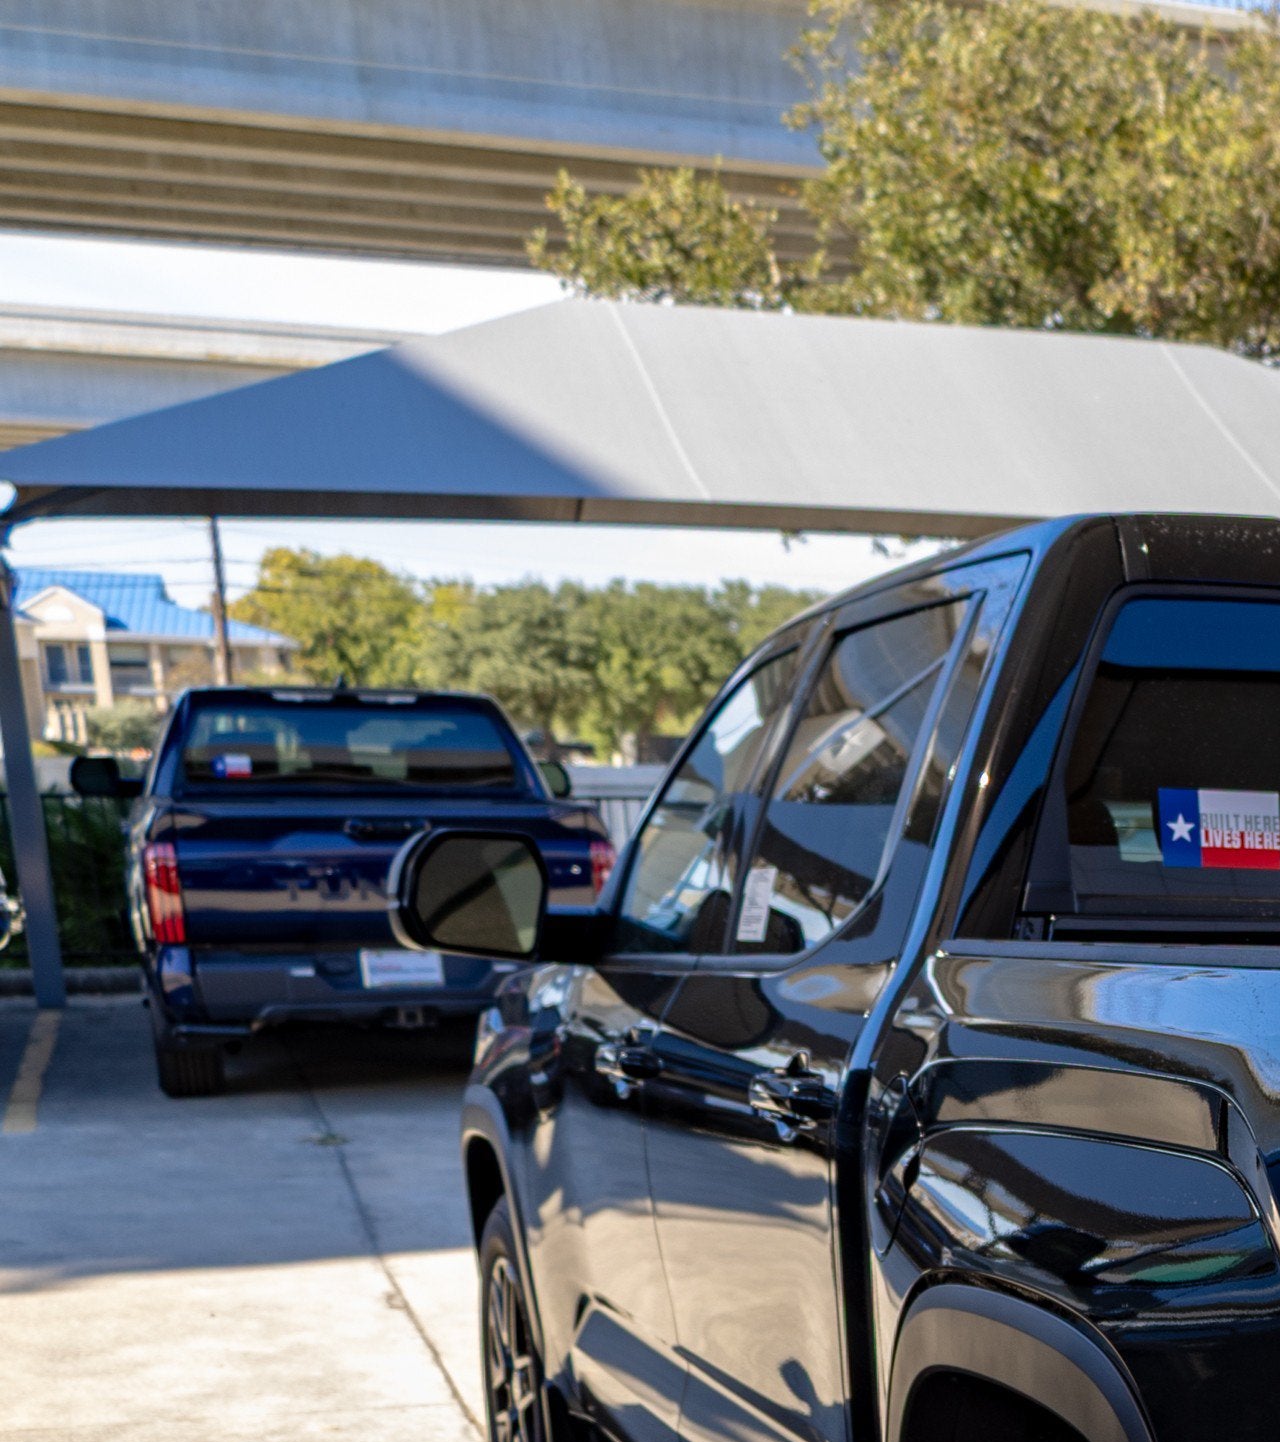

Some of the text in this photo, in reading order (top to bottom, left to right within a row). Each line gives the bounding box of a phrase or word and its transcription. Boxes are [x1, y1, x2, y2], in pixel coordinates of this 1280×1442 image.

[1200, 813, 1280, 832] BUILT HERE
[1201, 829, 1241, 848] LIVES
